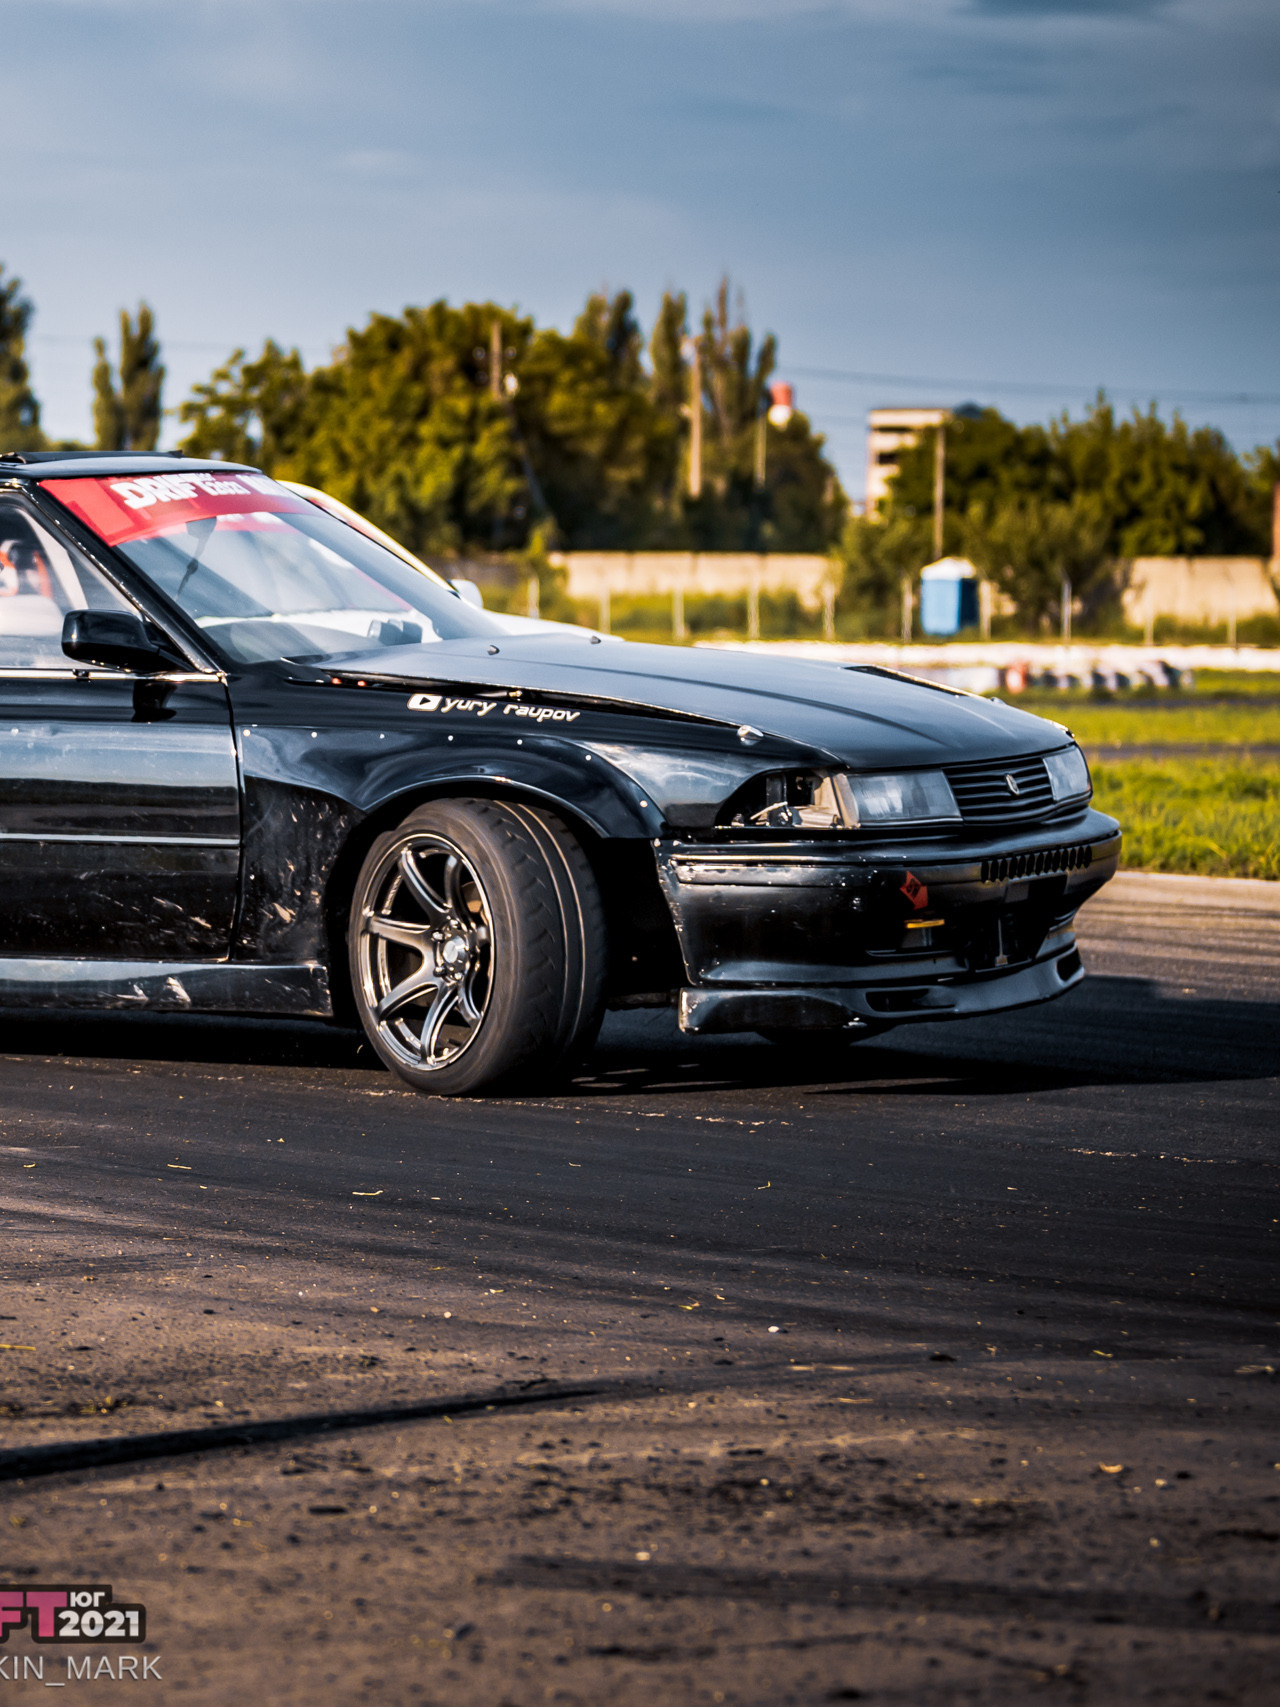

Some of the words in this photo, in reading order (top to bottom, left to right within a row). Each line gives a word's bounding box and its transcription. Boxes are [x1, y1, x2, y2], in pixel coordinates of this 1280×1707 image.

[110, 473, 218, 509] DRIFT
[441, 697, 497, 717] yury
[503, 703, 581, 723] raupov
